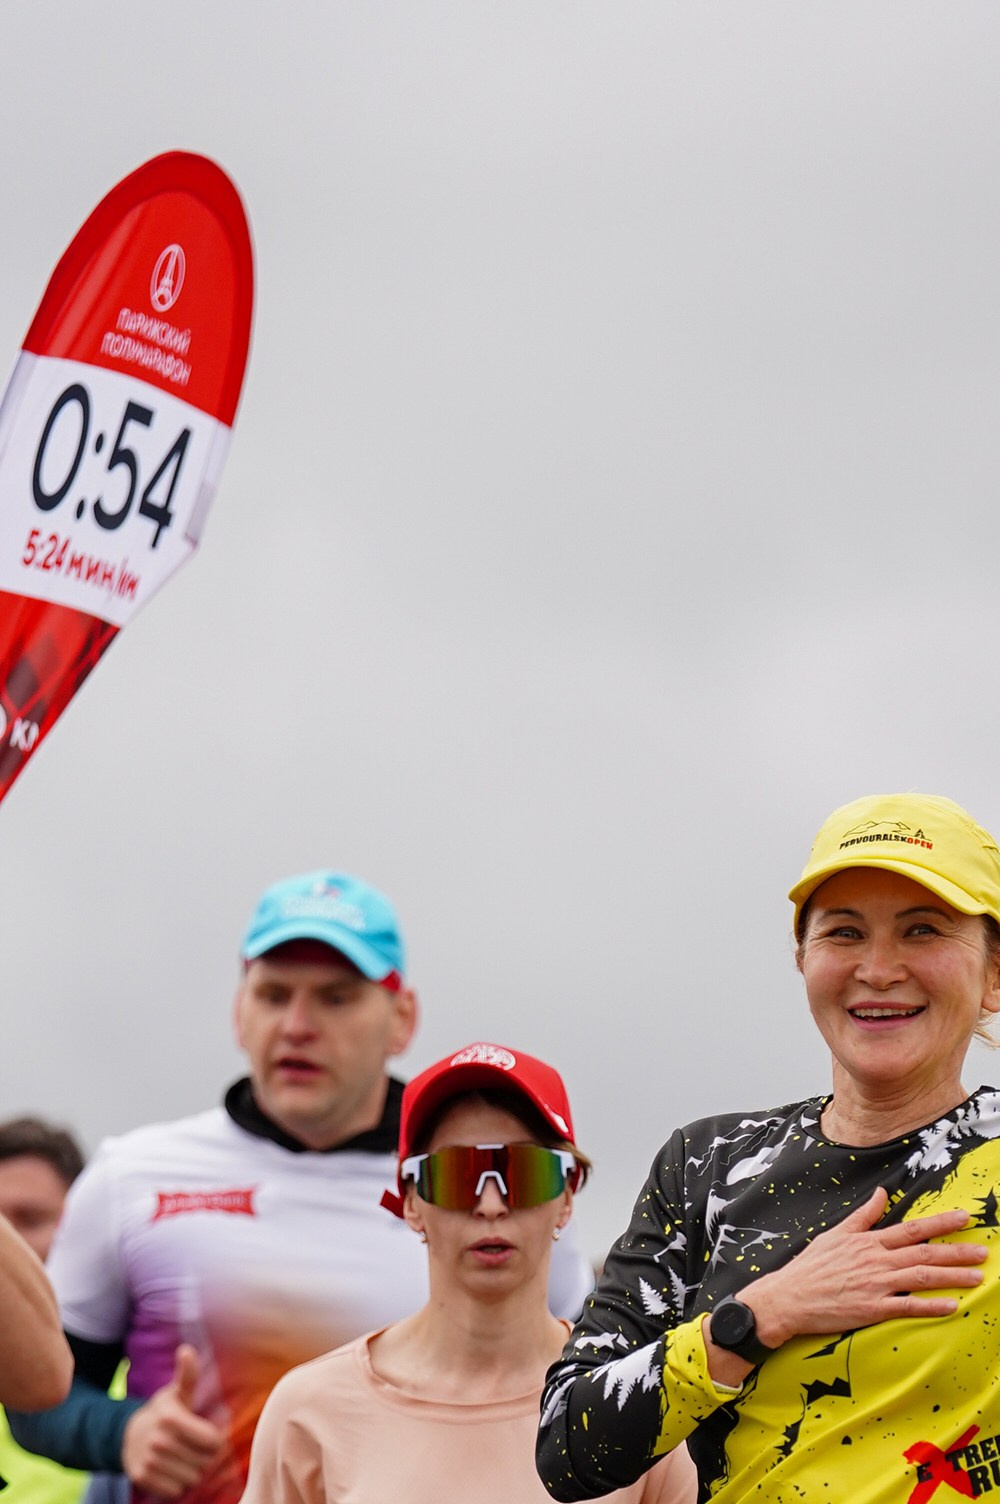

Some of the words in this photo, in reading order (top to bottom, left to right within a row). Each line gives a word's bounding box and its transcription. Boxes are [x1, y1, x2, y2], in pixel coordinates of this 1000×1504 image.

[100, 331, 192, 386] ПОЛУМАРАФОН
[116, 307, 192, 356] ПАРИЖСКИЙ
[32, 383, 191, 549] 0:54
